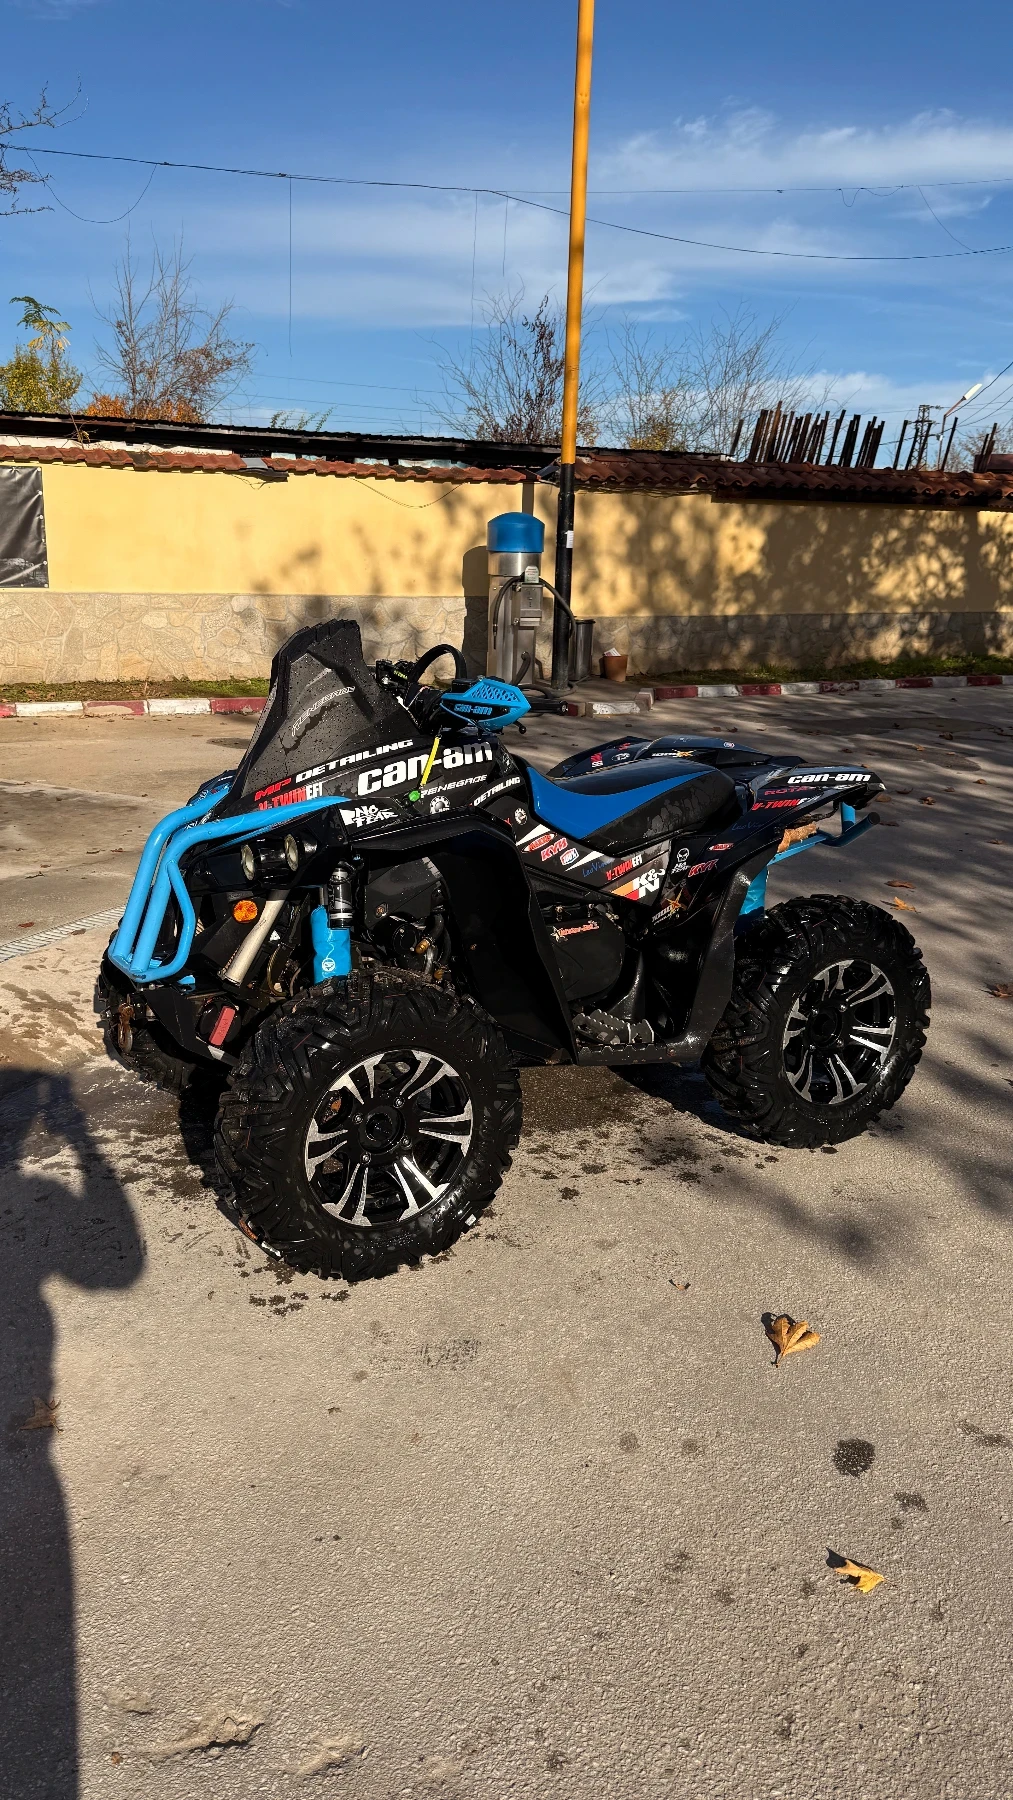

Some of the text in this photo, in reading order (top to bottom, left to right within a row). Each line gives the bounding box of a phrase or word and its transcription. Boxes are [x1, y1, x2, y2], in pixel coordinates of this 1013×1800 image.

[295, 739, 413, 783] DETAILING
[357, 741, 492, 796] can-am
[788, 773, 871, 784] can-am
[474, 776, 520, 806] DETAILING
